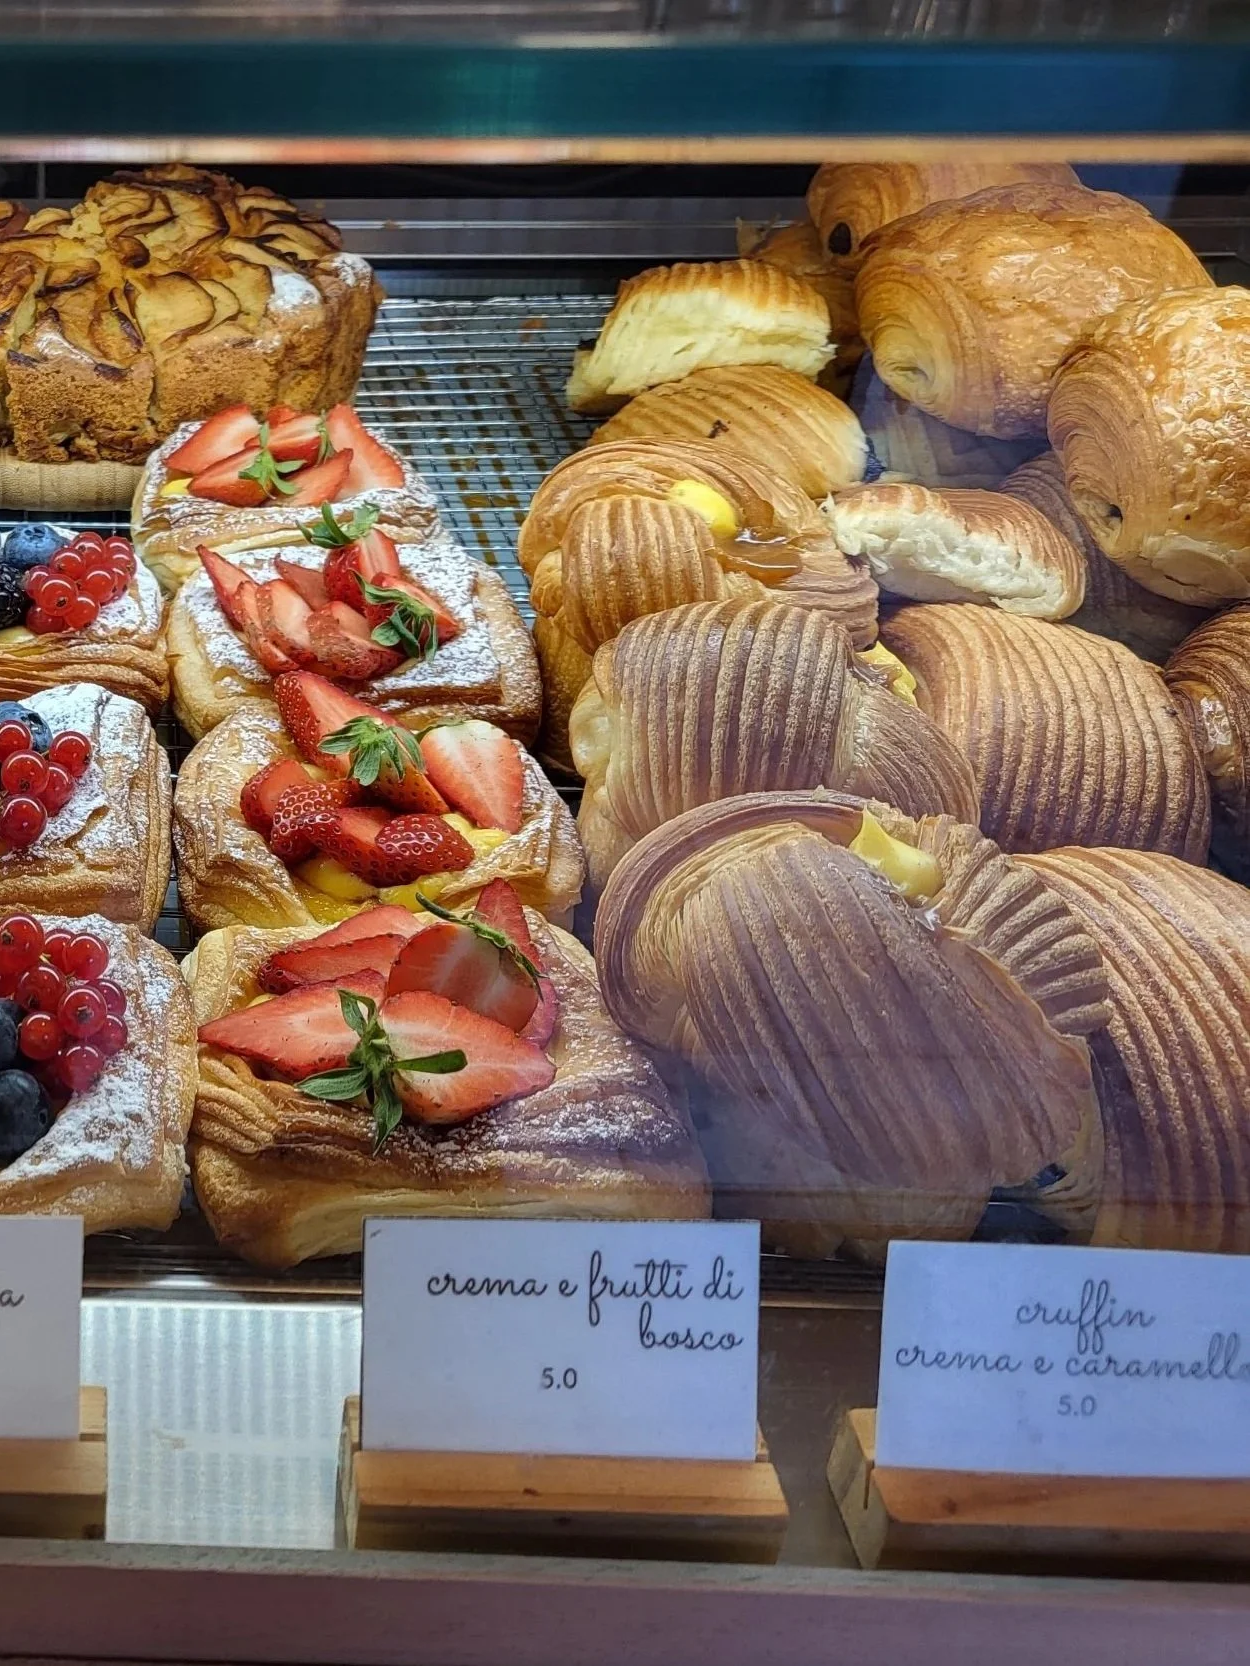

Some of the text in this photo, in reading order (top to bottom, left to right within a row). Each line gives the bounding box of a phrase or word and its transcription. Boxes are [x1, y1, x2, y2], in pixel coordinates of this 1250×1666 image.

[426, 1249, 745, 1328] crema e frutti di
[638, 1300, 744, 1351] bosco
[1015, 1278, 1157, 1356] cruffin
[540, 1366, 578, 1390] 5.0
[894, 1345, 1024, 1374] crema
[1033, 1355, 1054, 1376] e
[1056, 1394, 1098, 1418] 5.0
